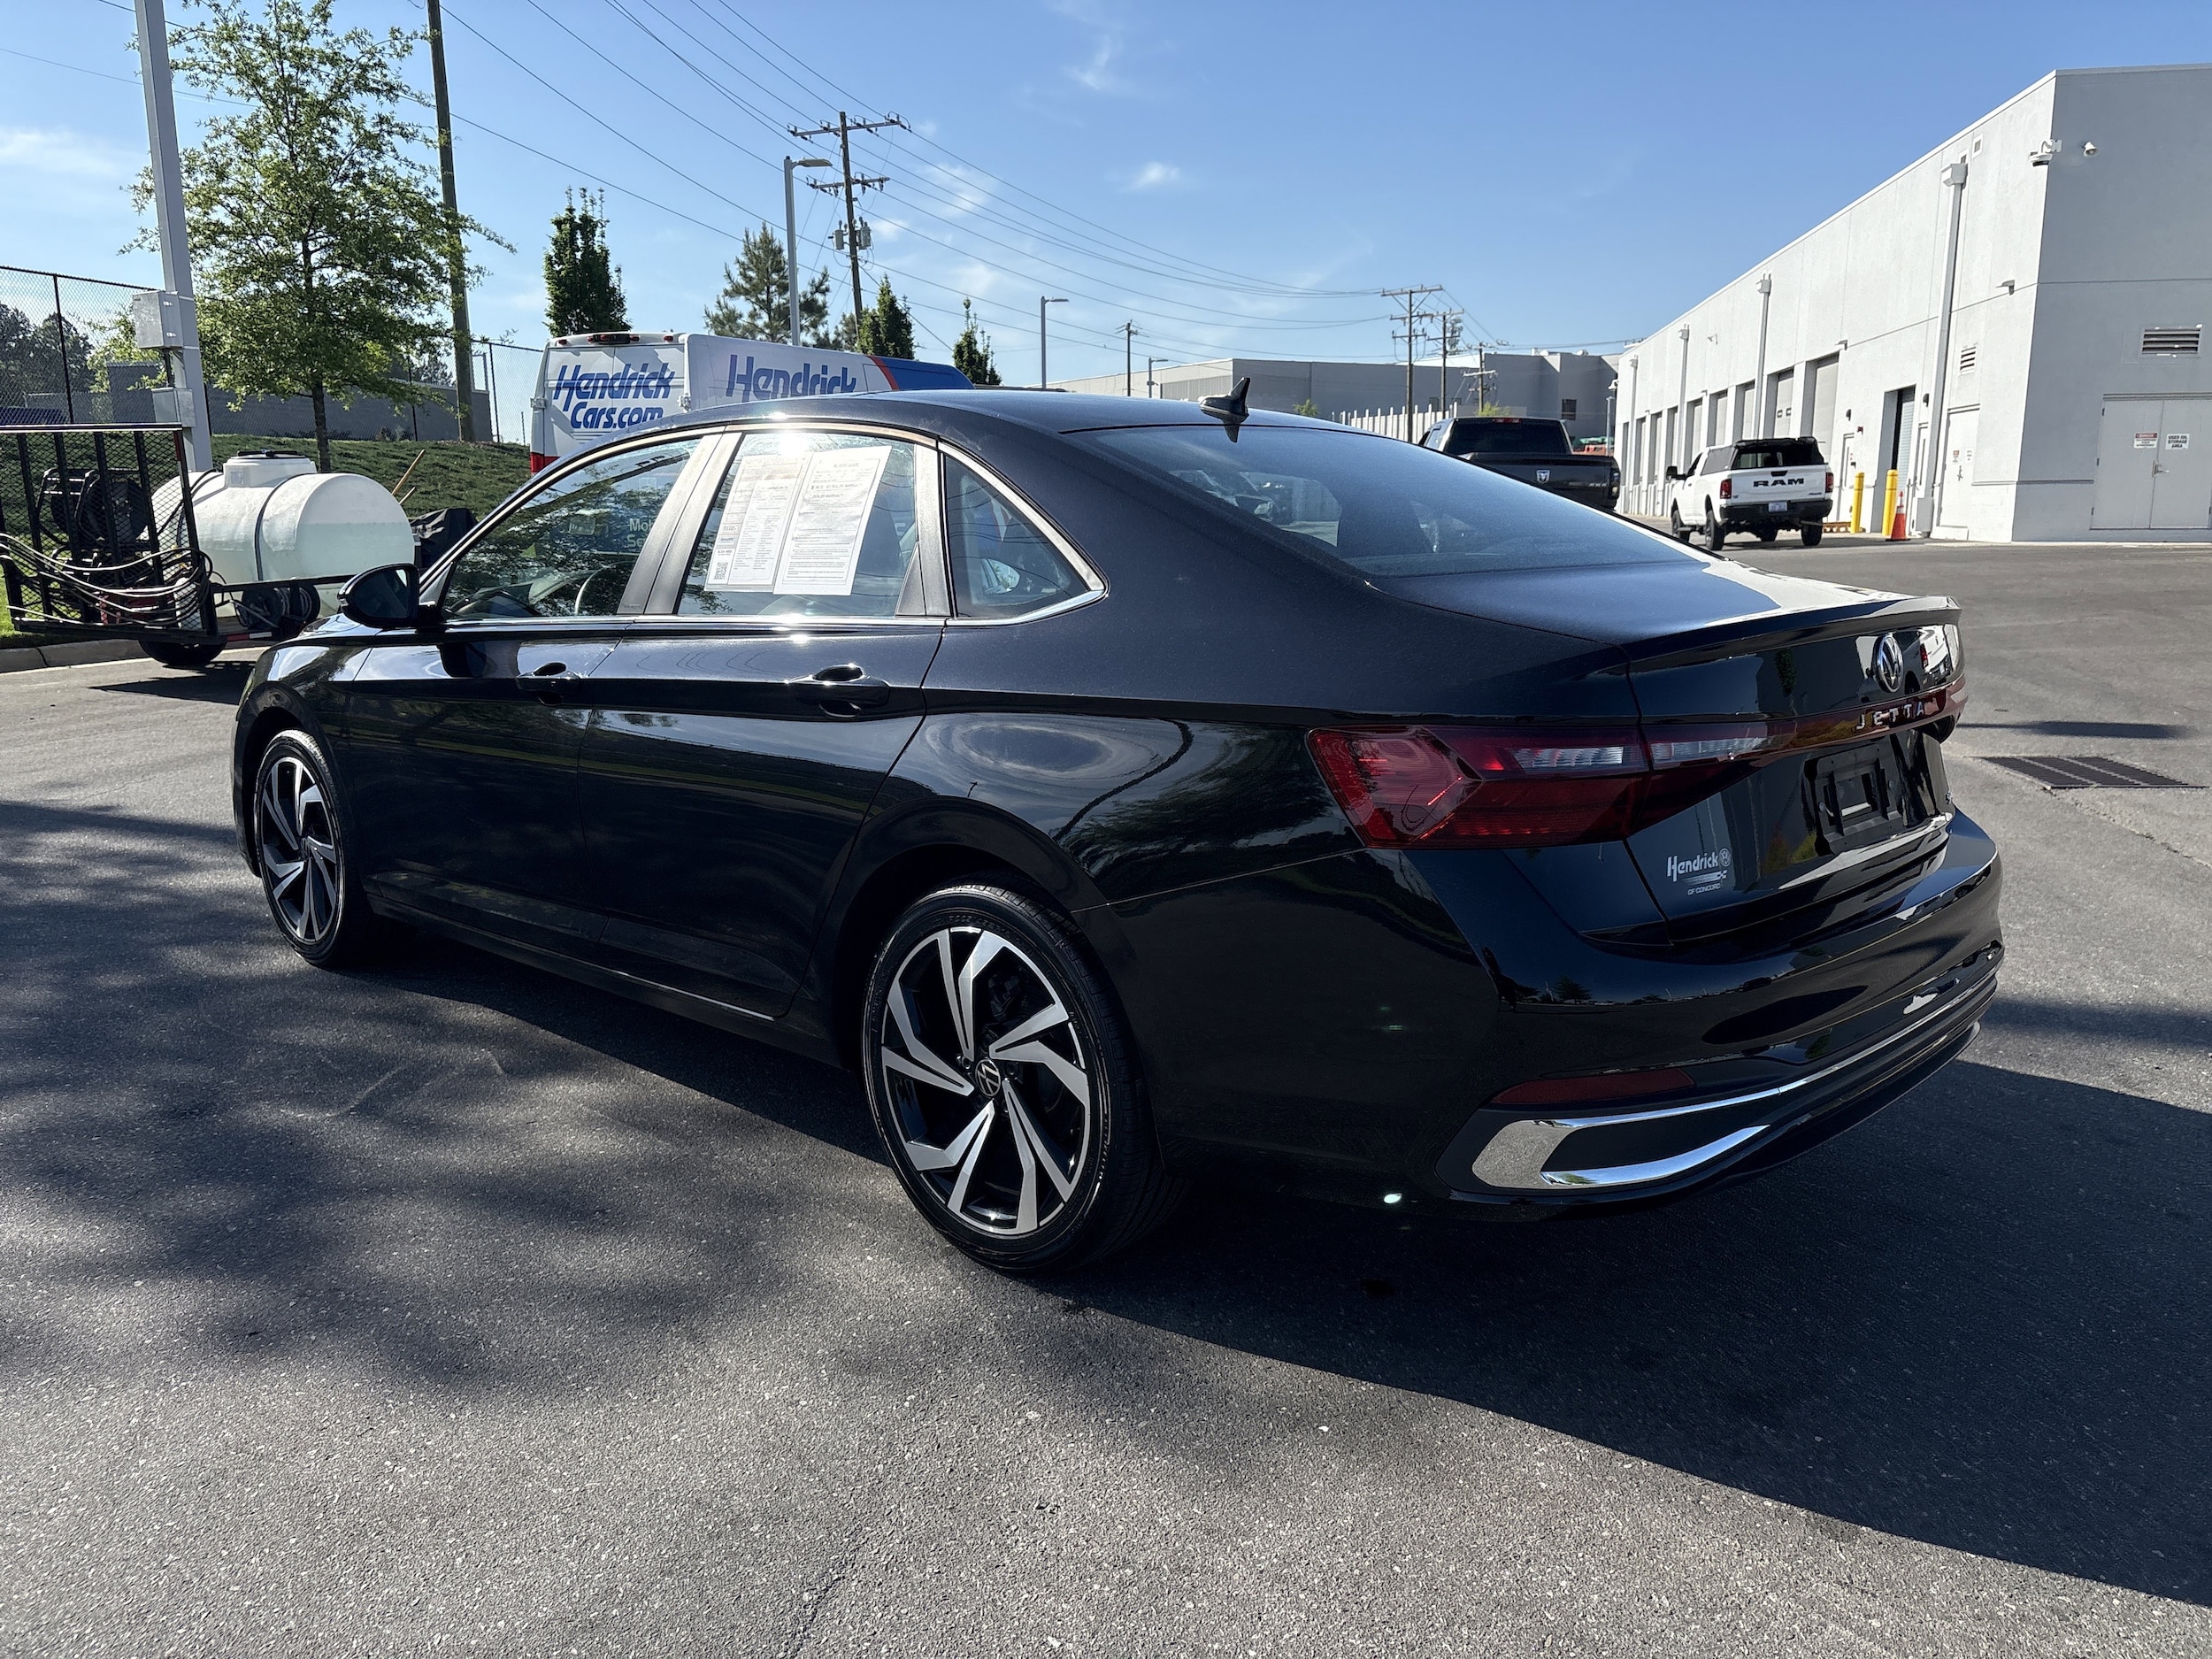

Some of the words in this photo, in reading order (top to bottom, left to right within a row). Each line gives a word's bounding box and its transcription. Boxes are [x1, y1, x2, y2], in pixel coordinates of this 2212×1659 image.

[553, 362, 676, 411] Hendrick
[726, 354, 856, 403] Hendrick
[570, 401, 664, 429] Cars.com
[1753, 478, 1804, 488] RAM
[1856, 701, 1924, 729] JETTA
[1667, 851, 1718, 882] Hendrick
[1695, 883, 1721, 894] CONCORD
